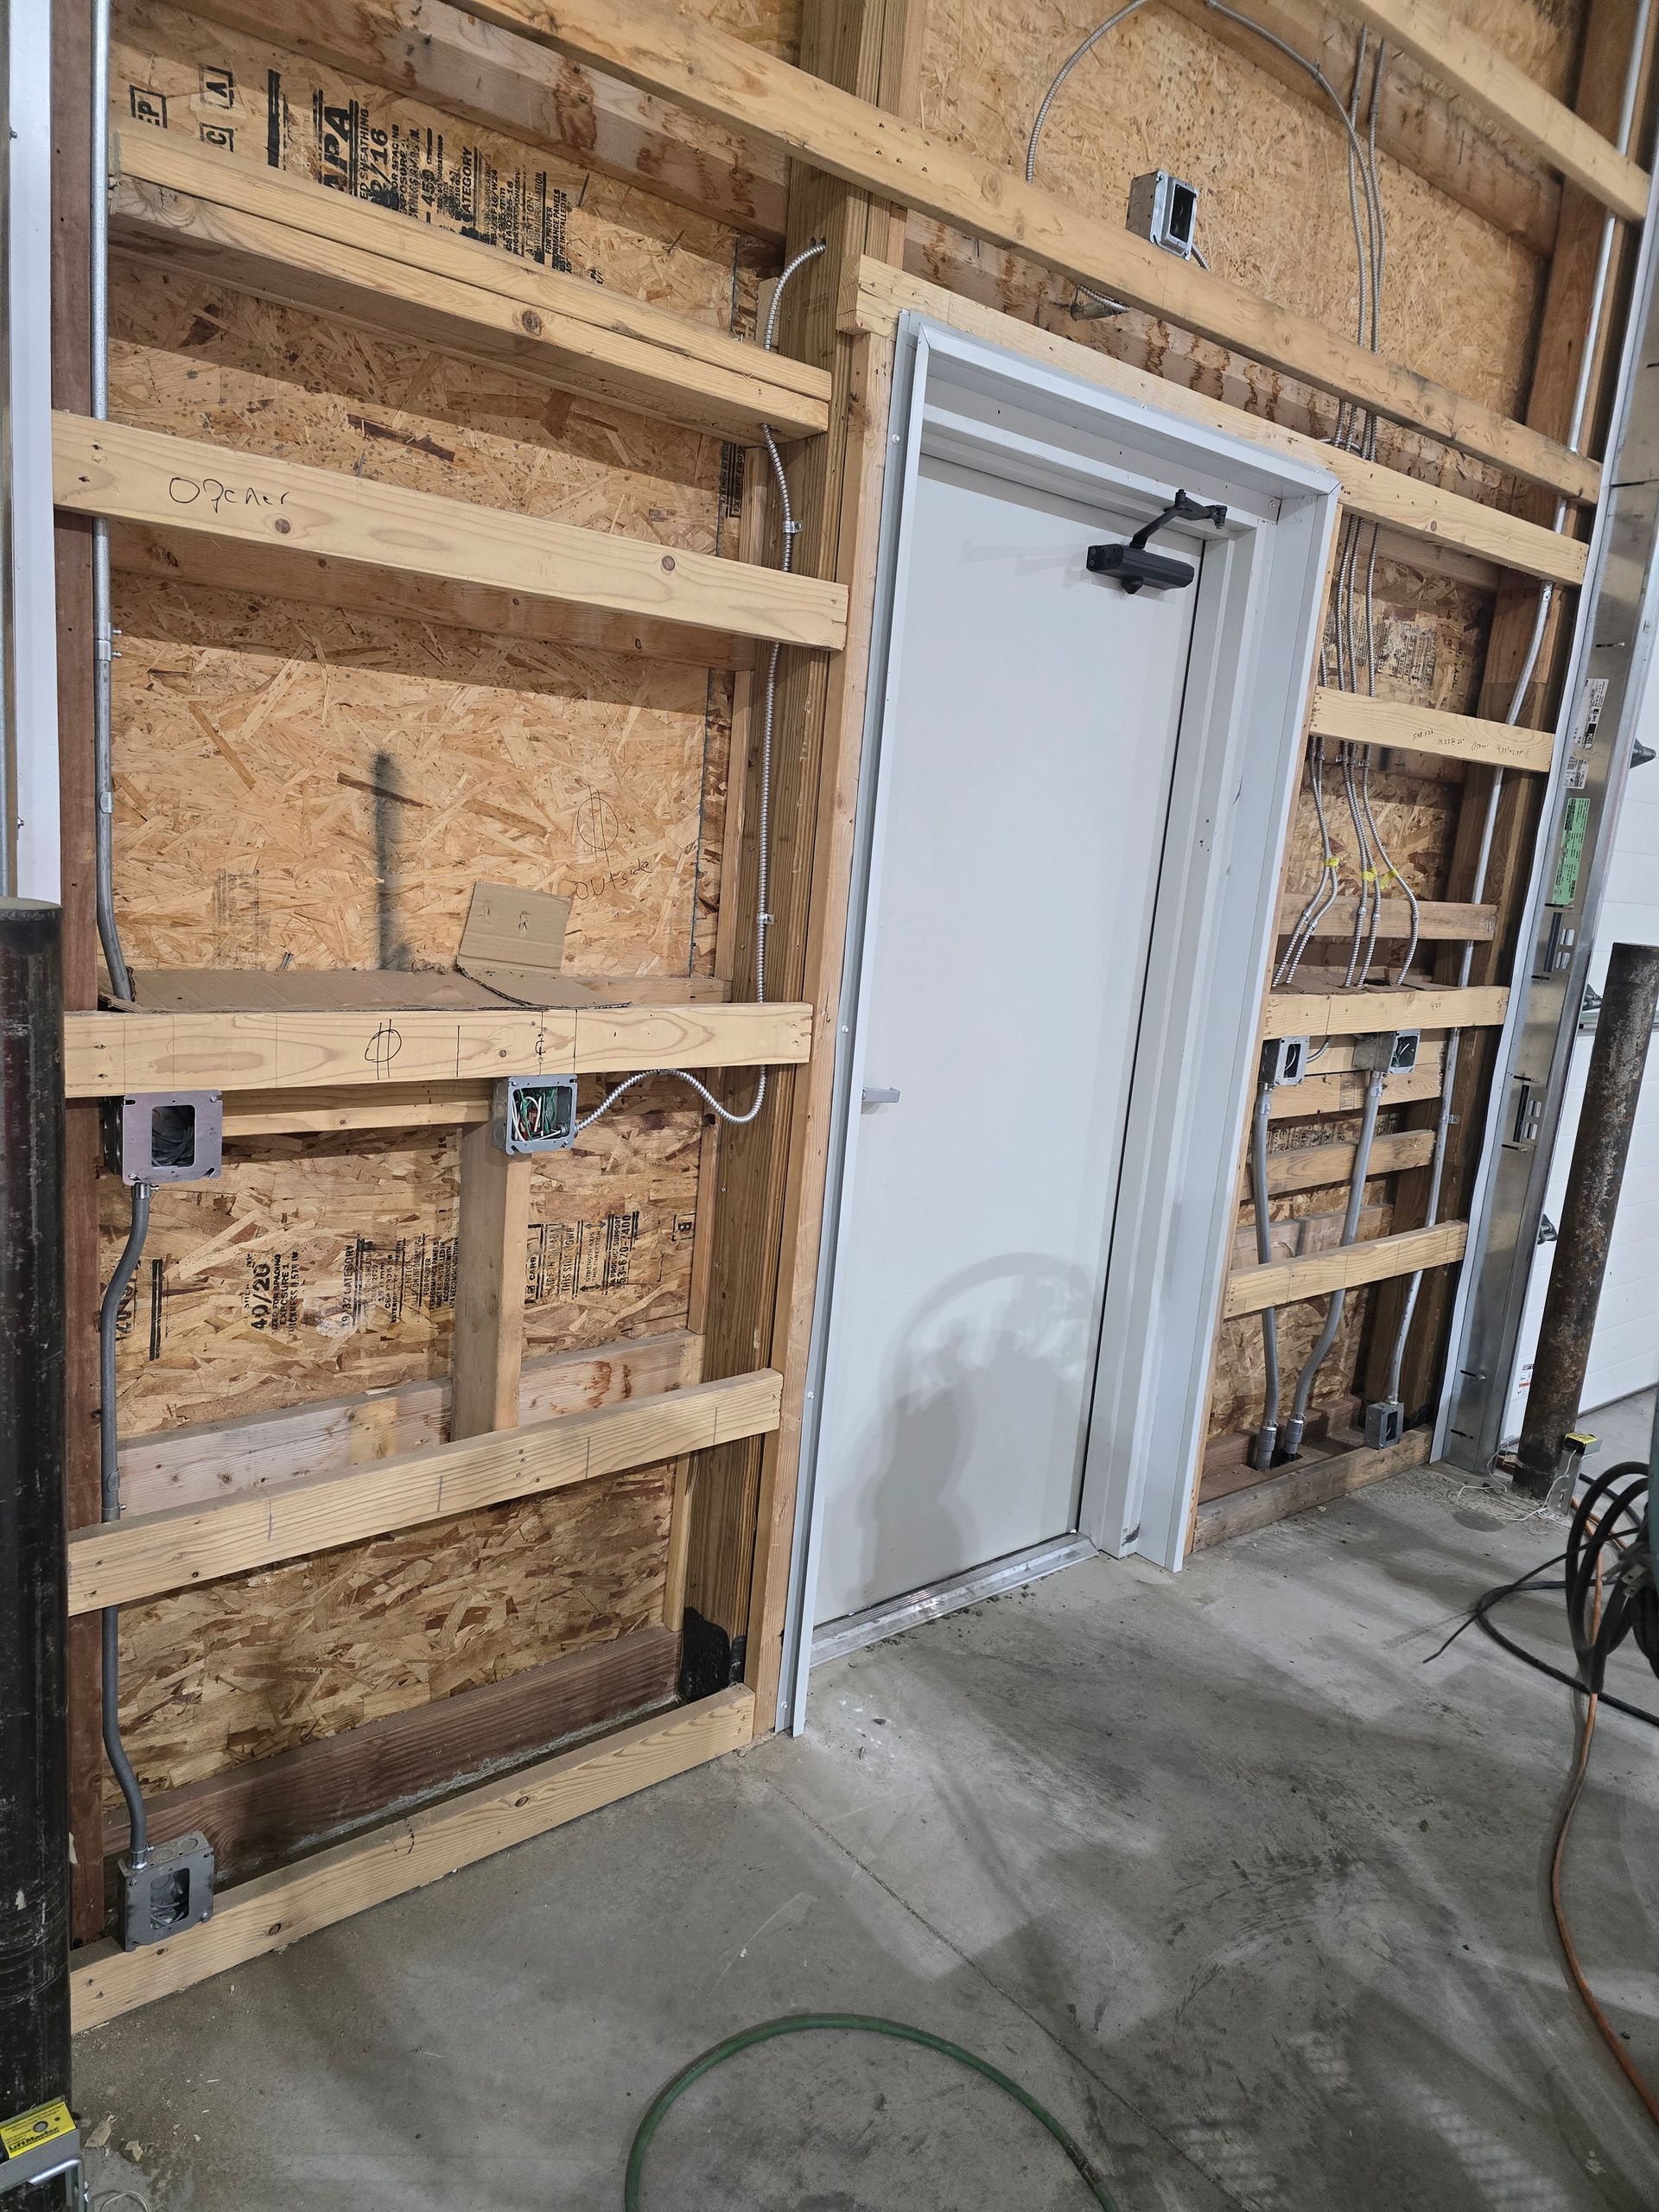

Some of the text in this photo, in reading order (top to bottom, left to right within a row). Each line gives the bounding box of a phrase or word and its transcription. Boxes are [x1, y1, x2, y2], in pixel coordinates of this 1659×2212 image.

[206, 130, 227, 145] C
[370, 128, 391, 205] 2/16
[612, 1216, 621, 1246] SUPPORT
[343, 1244, 354, 1294] CATEGORY
[610, 1247, 619, 1278] PRODUCT
[251, 1263, 271, 1330] 40/20
[280, 1271, 289, 1325] EXPOSURE
[562, 1274, 571, 1292] THIS
[9, 2127, 60, 2152] LiftMaster
